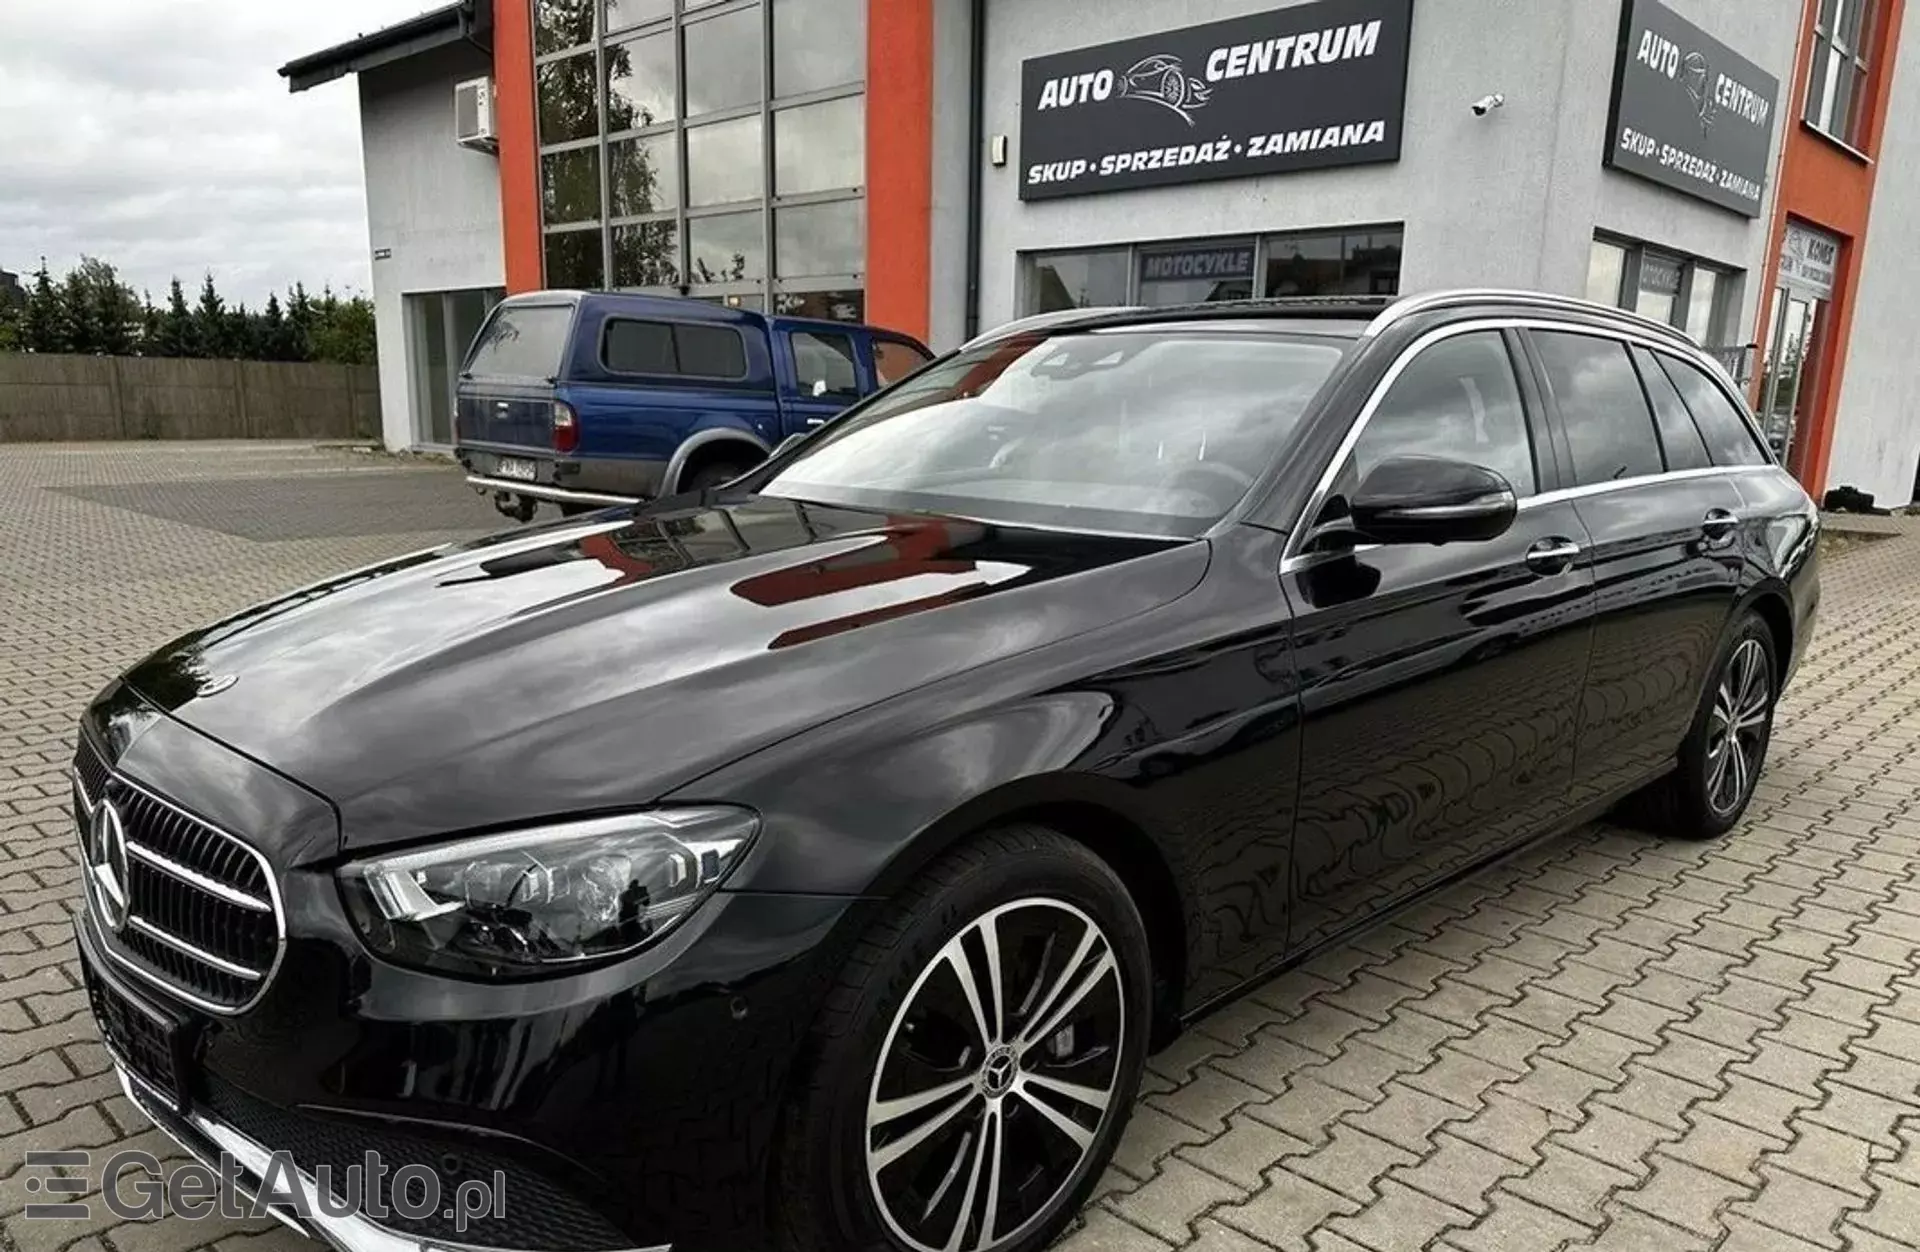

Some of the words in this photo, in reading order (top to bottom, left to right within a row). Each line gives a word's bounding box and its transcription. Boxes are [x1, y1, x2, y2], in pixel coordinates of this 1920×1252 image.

[1037, 69, 1115, 111] AUTO
[1206, 20, 1382, 82] CENTRUM
[1636, 29, 1680, 80] AUTO
[1714, 72, 1769, 127] CENTRUM
[1028, 160, 1087, 184] SKUP
[1099, 135, 1232, 176] SPRZEDAŻ
[1247, 120, 1385, 157] ZAMIANA
[1620, 127, 1656, 158] SKUP
[1144, 252, 1251, 277] MOTOCYKLE
